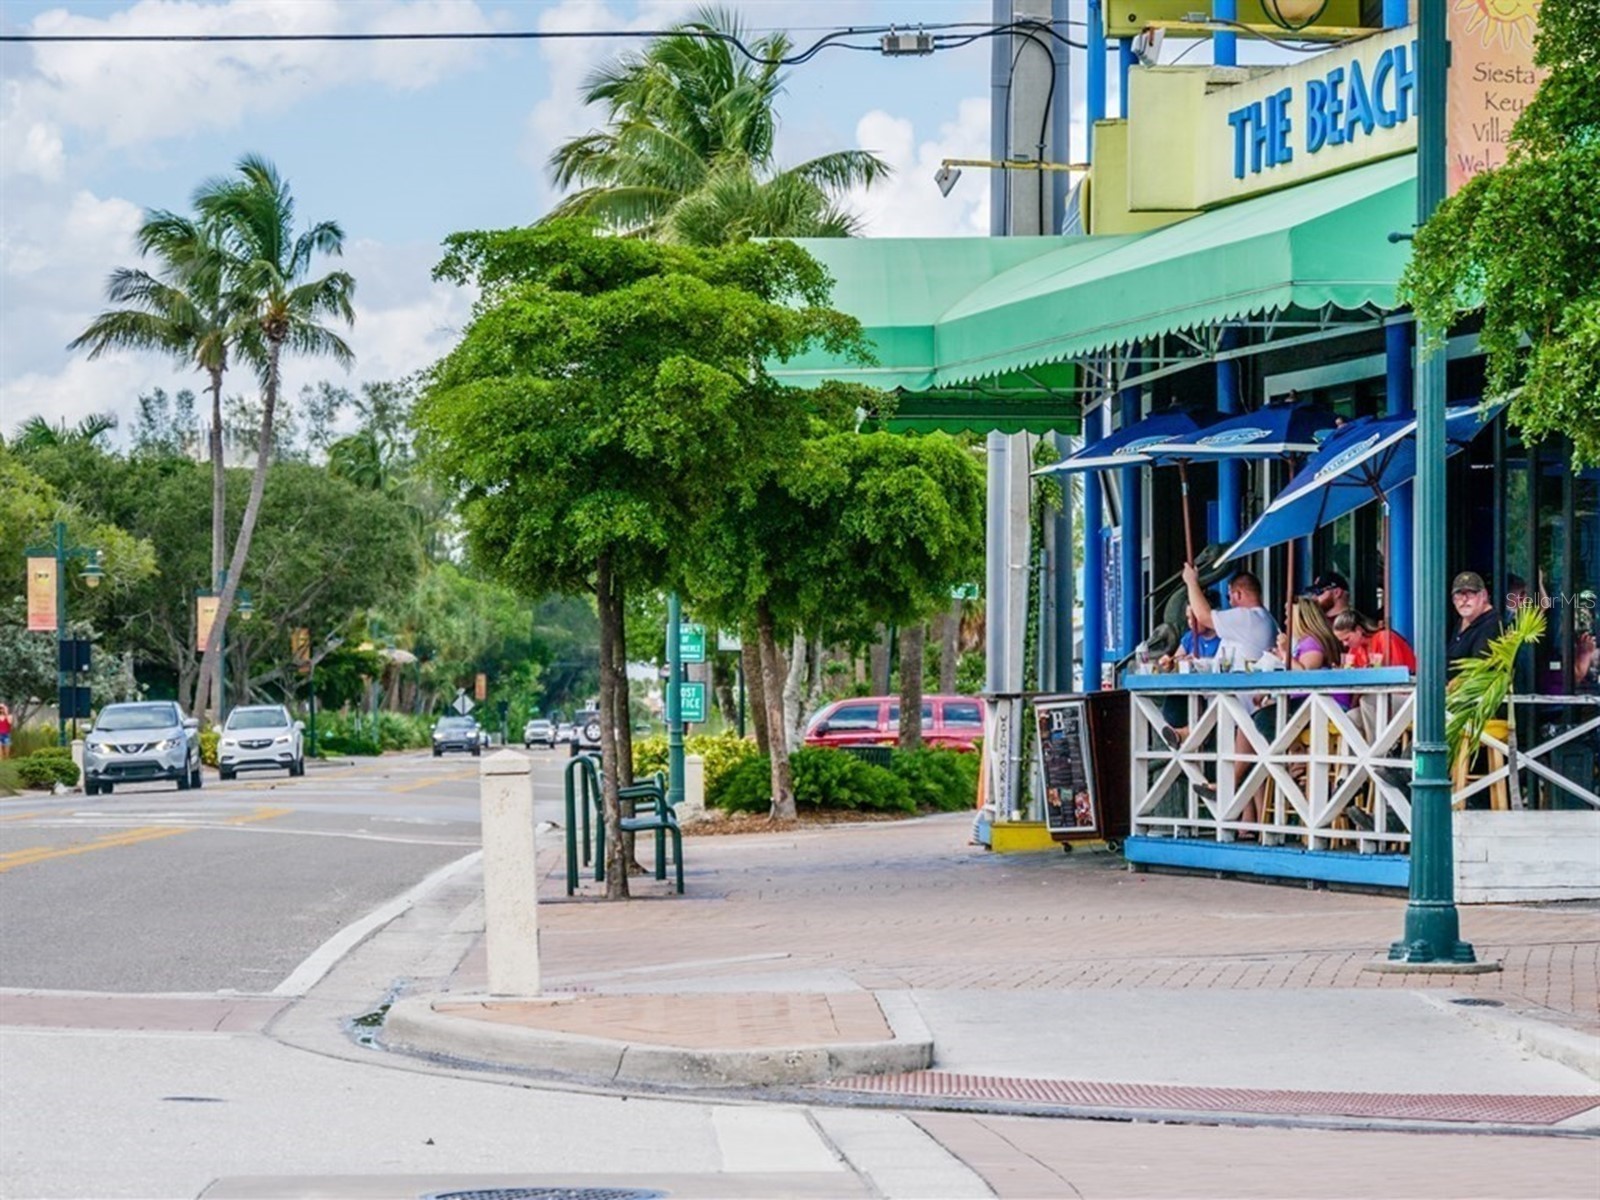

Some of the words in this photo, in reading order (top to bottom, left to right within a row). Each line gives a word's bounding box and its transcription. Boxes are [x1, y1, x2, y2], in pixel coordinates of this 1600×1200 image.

[1472, 62, 1536, 85] Siesta
[1228, 87, 1293, 179] THE
[1306, 40, 1418, 153] BEACH
[1472, 117, 1511, 143] Villa
[681, 687, 696, 697] OST
[681, 698, 700, 709] FICE
